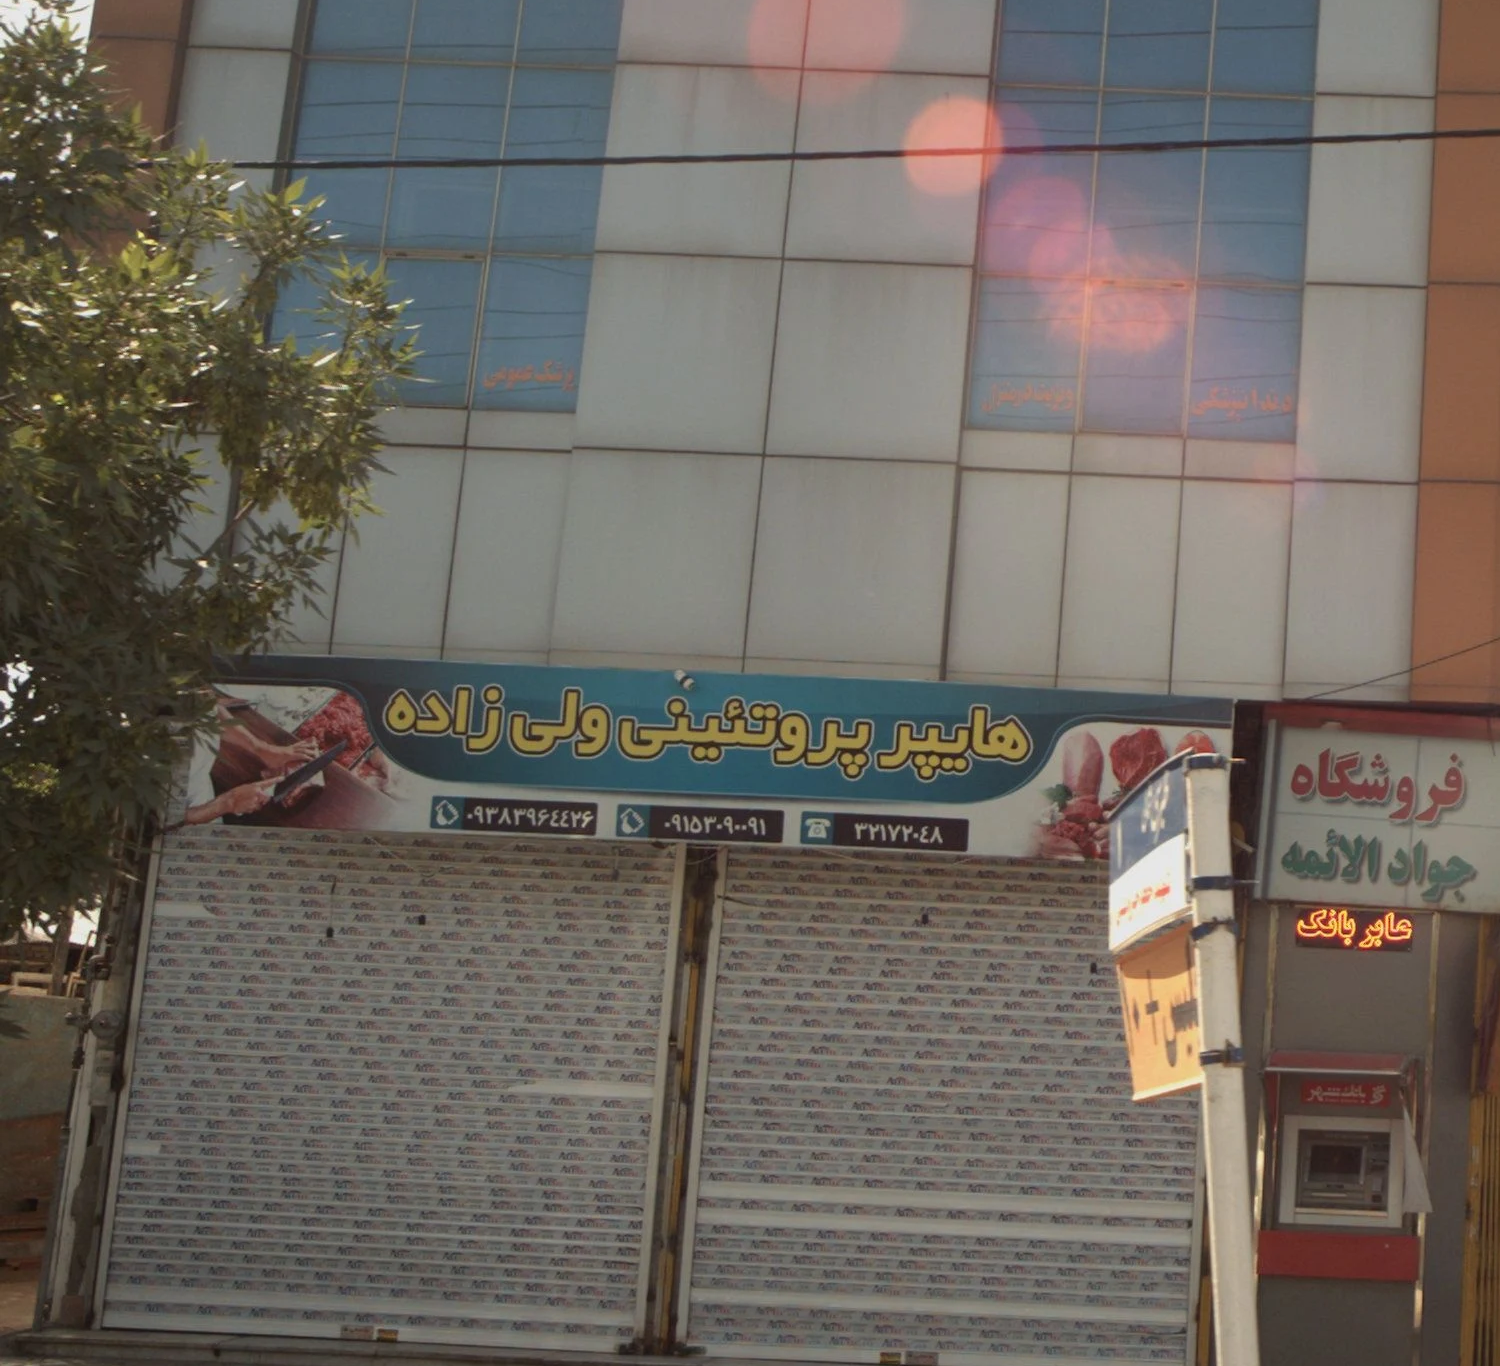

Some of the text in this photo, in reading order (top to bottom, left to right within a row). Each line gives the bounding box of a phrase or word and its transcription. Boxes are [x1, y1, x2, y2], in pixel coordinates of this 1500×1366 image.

[384, 684, 1033, 782] هایپر پروتئینی ولی زاده
[1290, 747, 1466, 825] فروشگاه
[1281, 828, 1478, 903] جواد الائمه
[1296, 907, 1413, 948] عابر بانک
